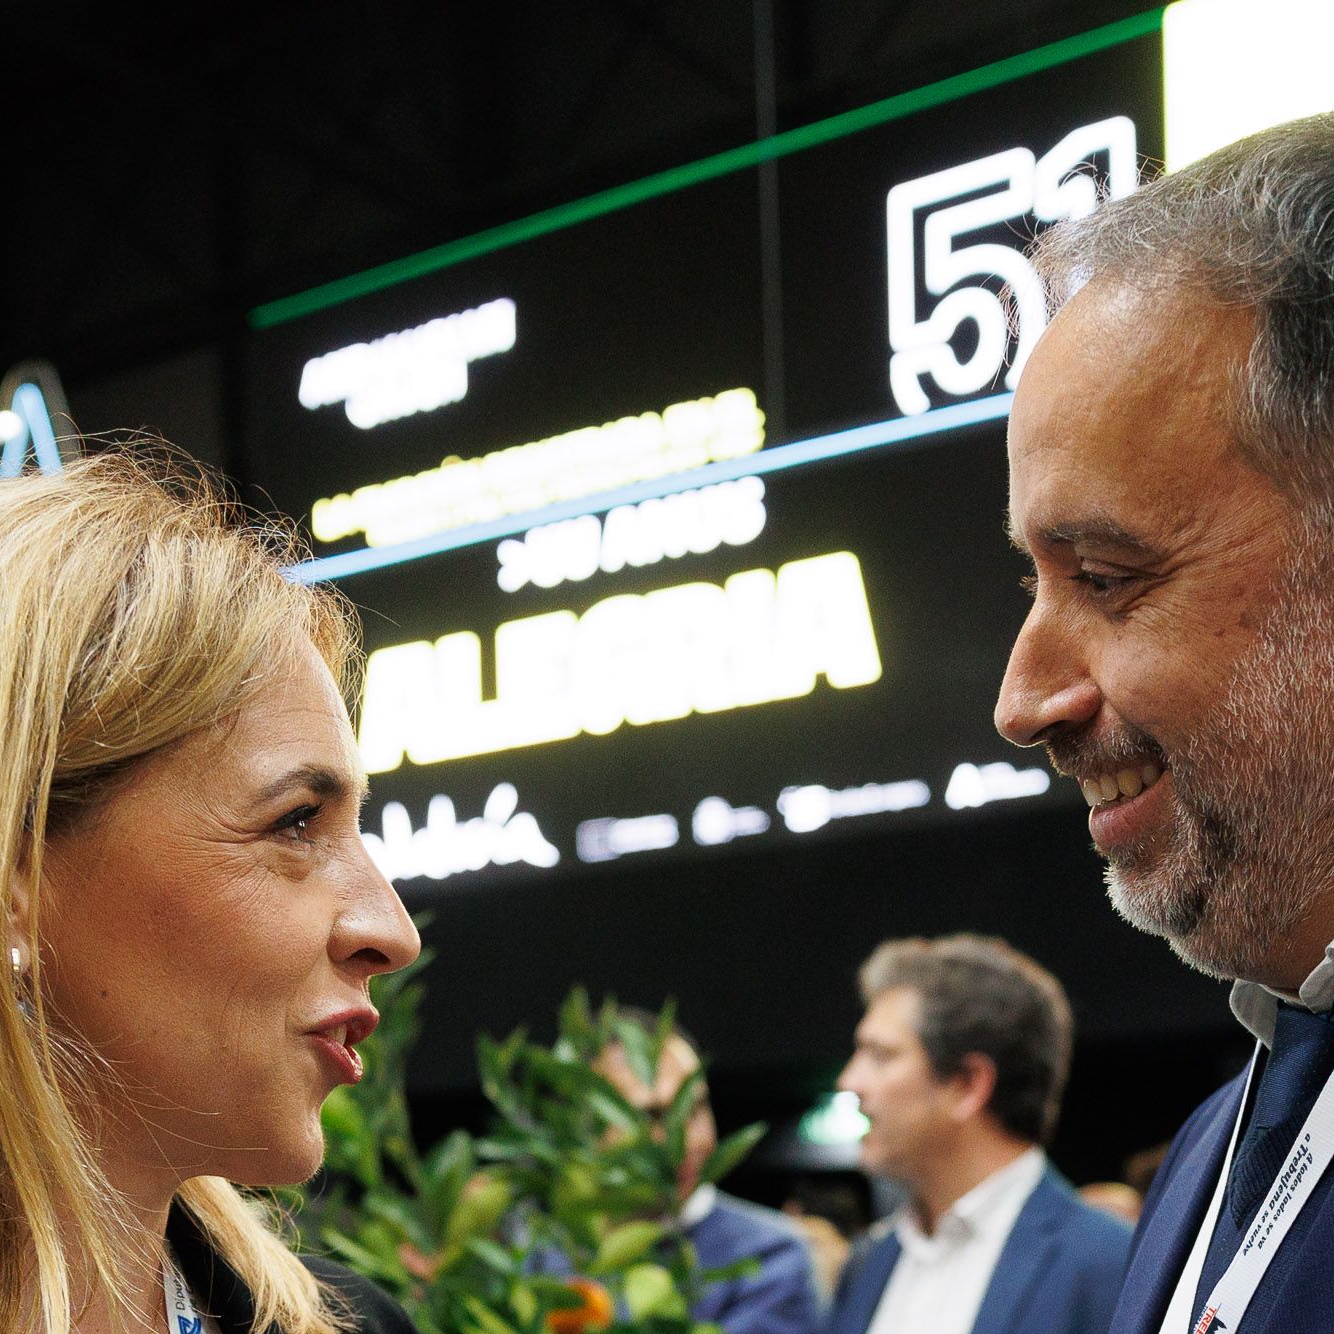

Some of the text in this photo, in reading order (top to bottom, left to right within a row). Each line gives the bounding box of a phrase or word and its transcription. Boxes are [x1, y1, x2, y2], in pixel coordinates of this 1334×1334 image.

[1243, 1133, 1311, 1256] a Trebujena se vuelve
[1257, 1153, 1313, 1249] A todos lados se va
